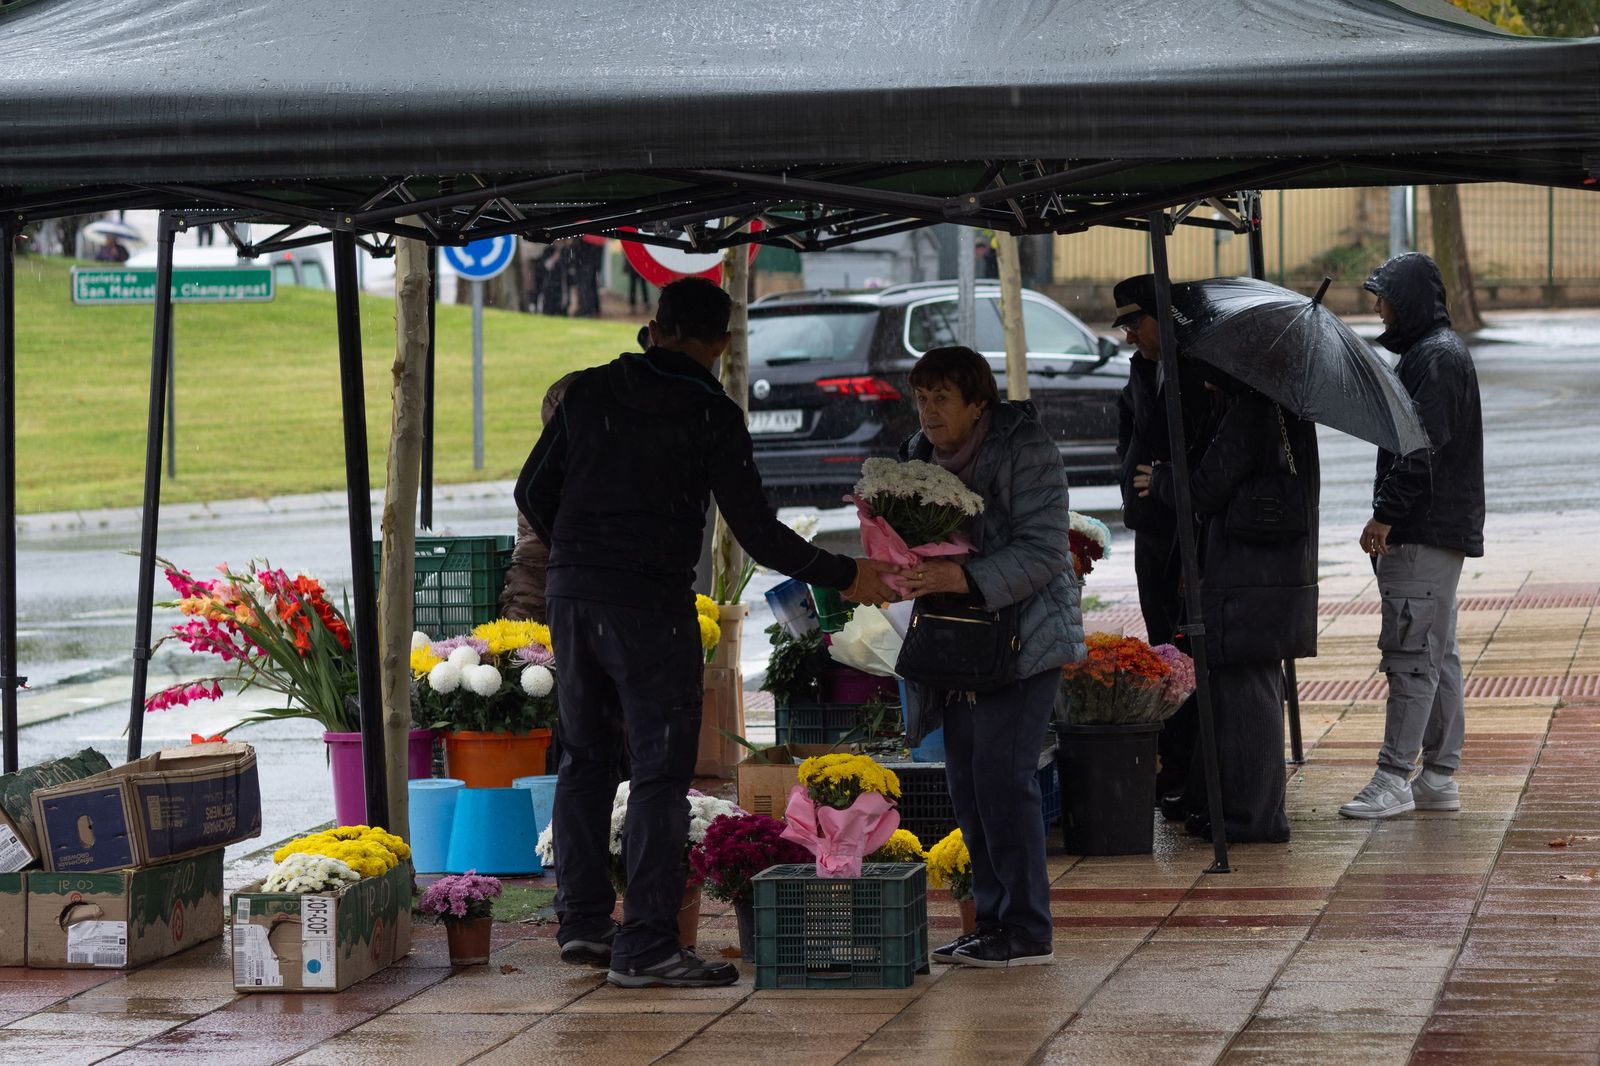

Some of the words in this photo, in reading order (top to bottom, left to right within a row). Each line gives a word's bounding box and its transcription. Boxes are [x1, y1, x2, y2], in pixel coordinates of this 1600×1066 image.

[124, 274, 137, 283] de
[79, 285, 106, 297] San
[109, 284, 177, 297] Marcelo
[181, 283, 267, 298] Champagnat
[1171, 305, 1194, 326] onal
